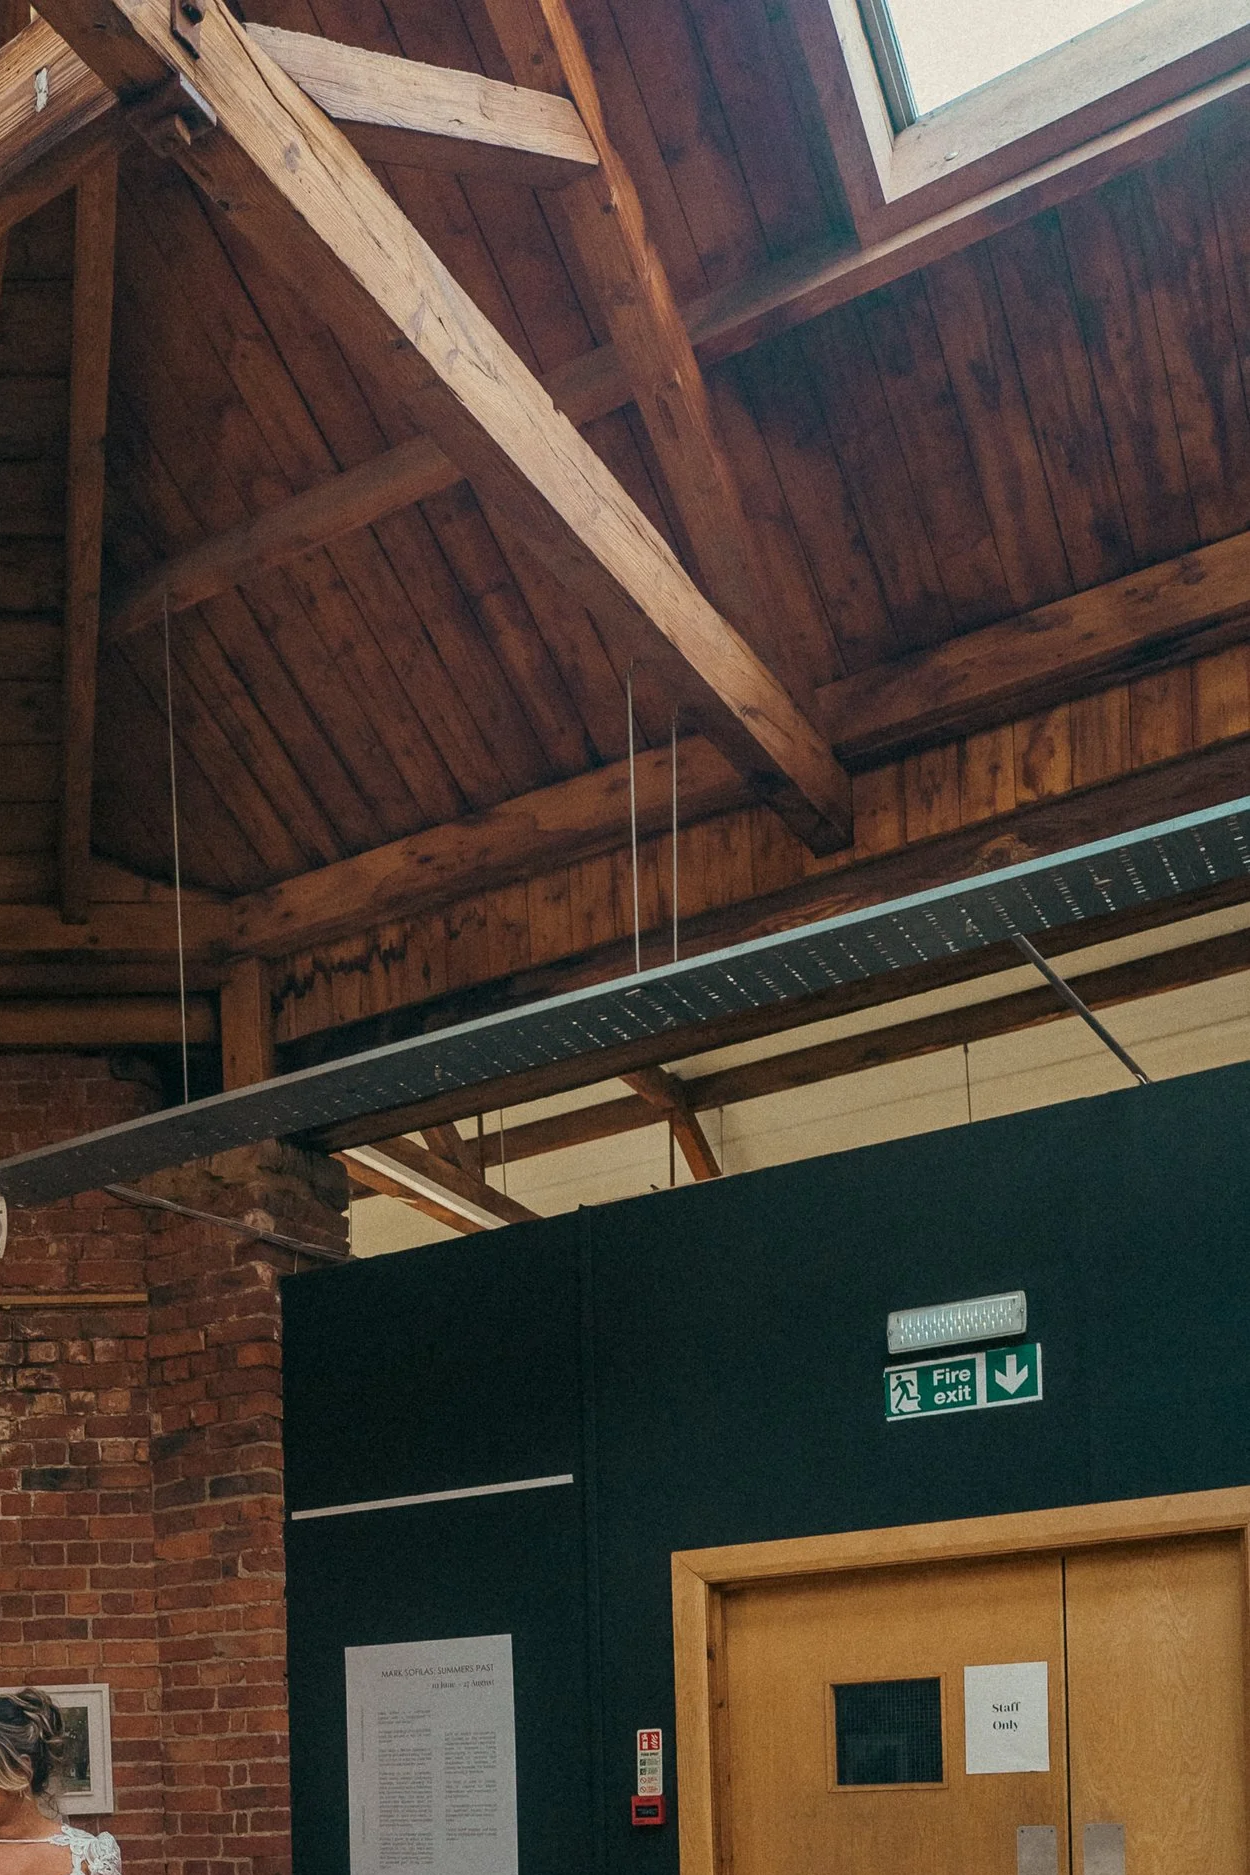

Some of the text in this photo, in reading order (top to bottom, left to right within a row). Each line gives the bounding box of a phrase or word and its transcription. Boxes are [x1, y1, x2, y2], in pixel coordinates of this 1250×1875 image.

[933, 1368, 971, 1386] Fire
[934, 1385, 971, 1405] exit
[381, 1669, 403, 1678] MARK
[437, 1664, 474, 1675] SUMMERS
[475, 1663, 494, 1673] PAST
[440, 1681, 456, 1689] June
[471, 1679, 495, 1689] August
[992, 1701, 1021, 1713] Staff
[992, 1719, 1019, 1732] Only
